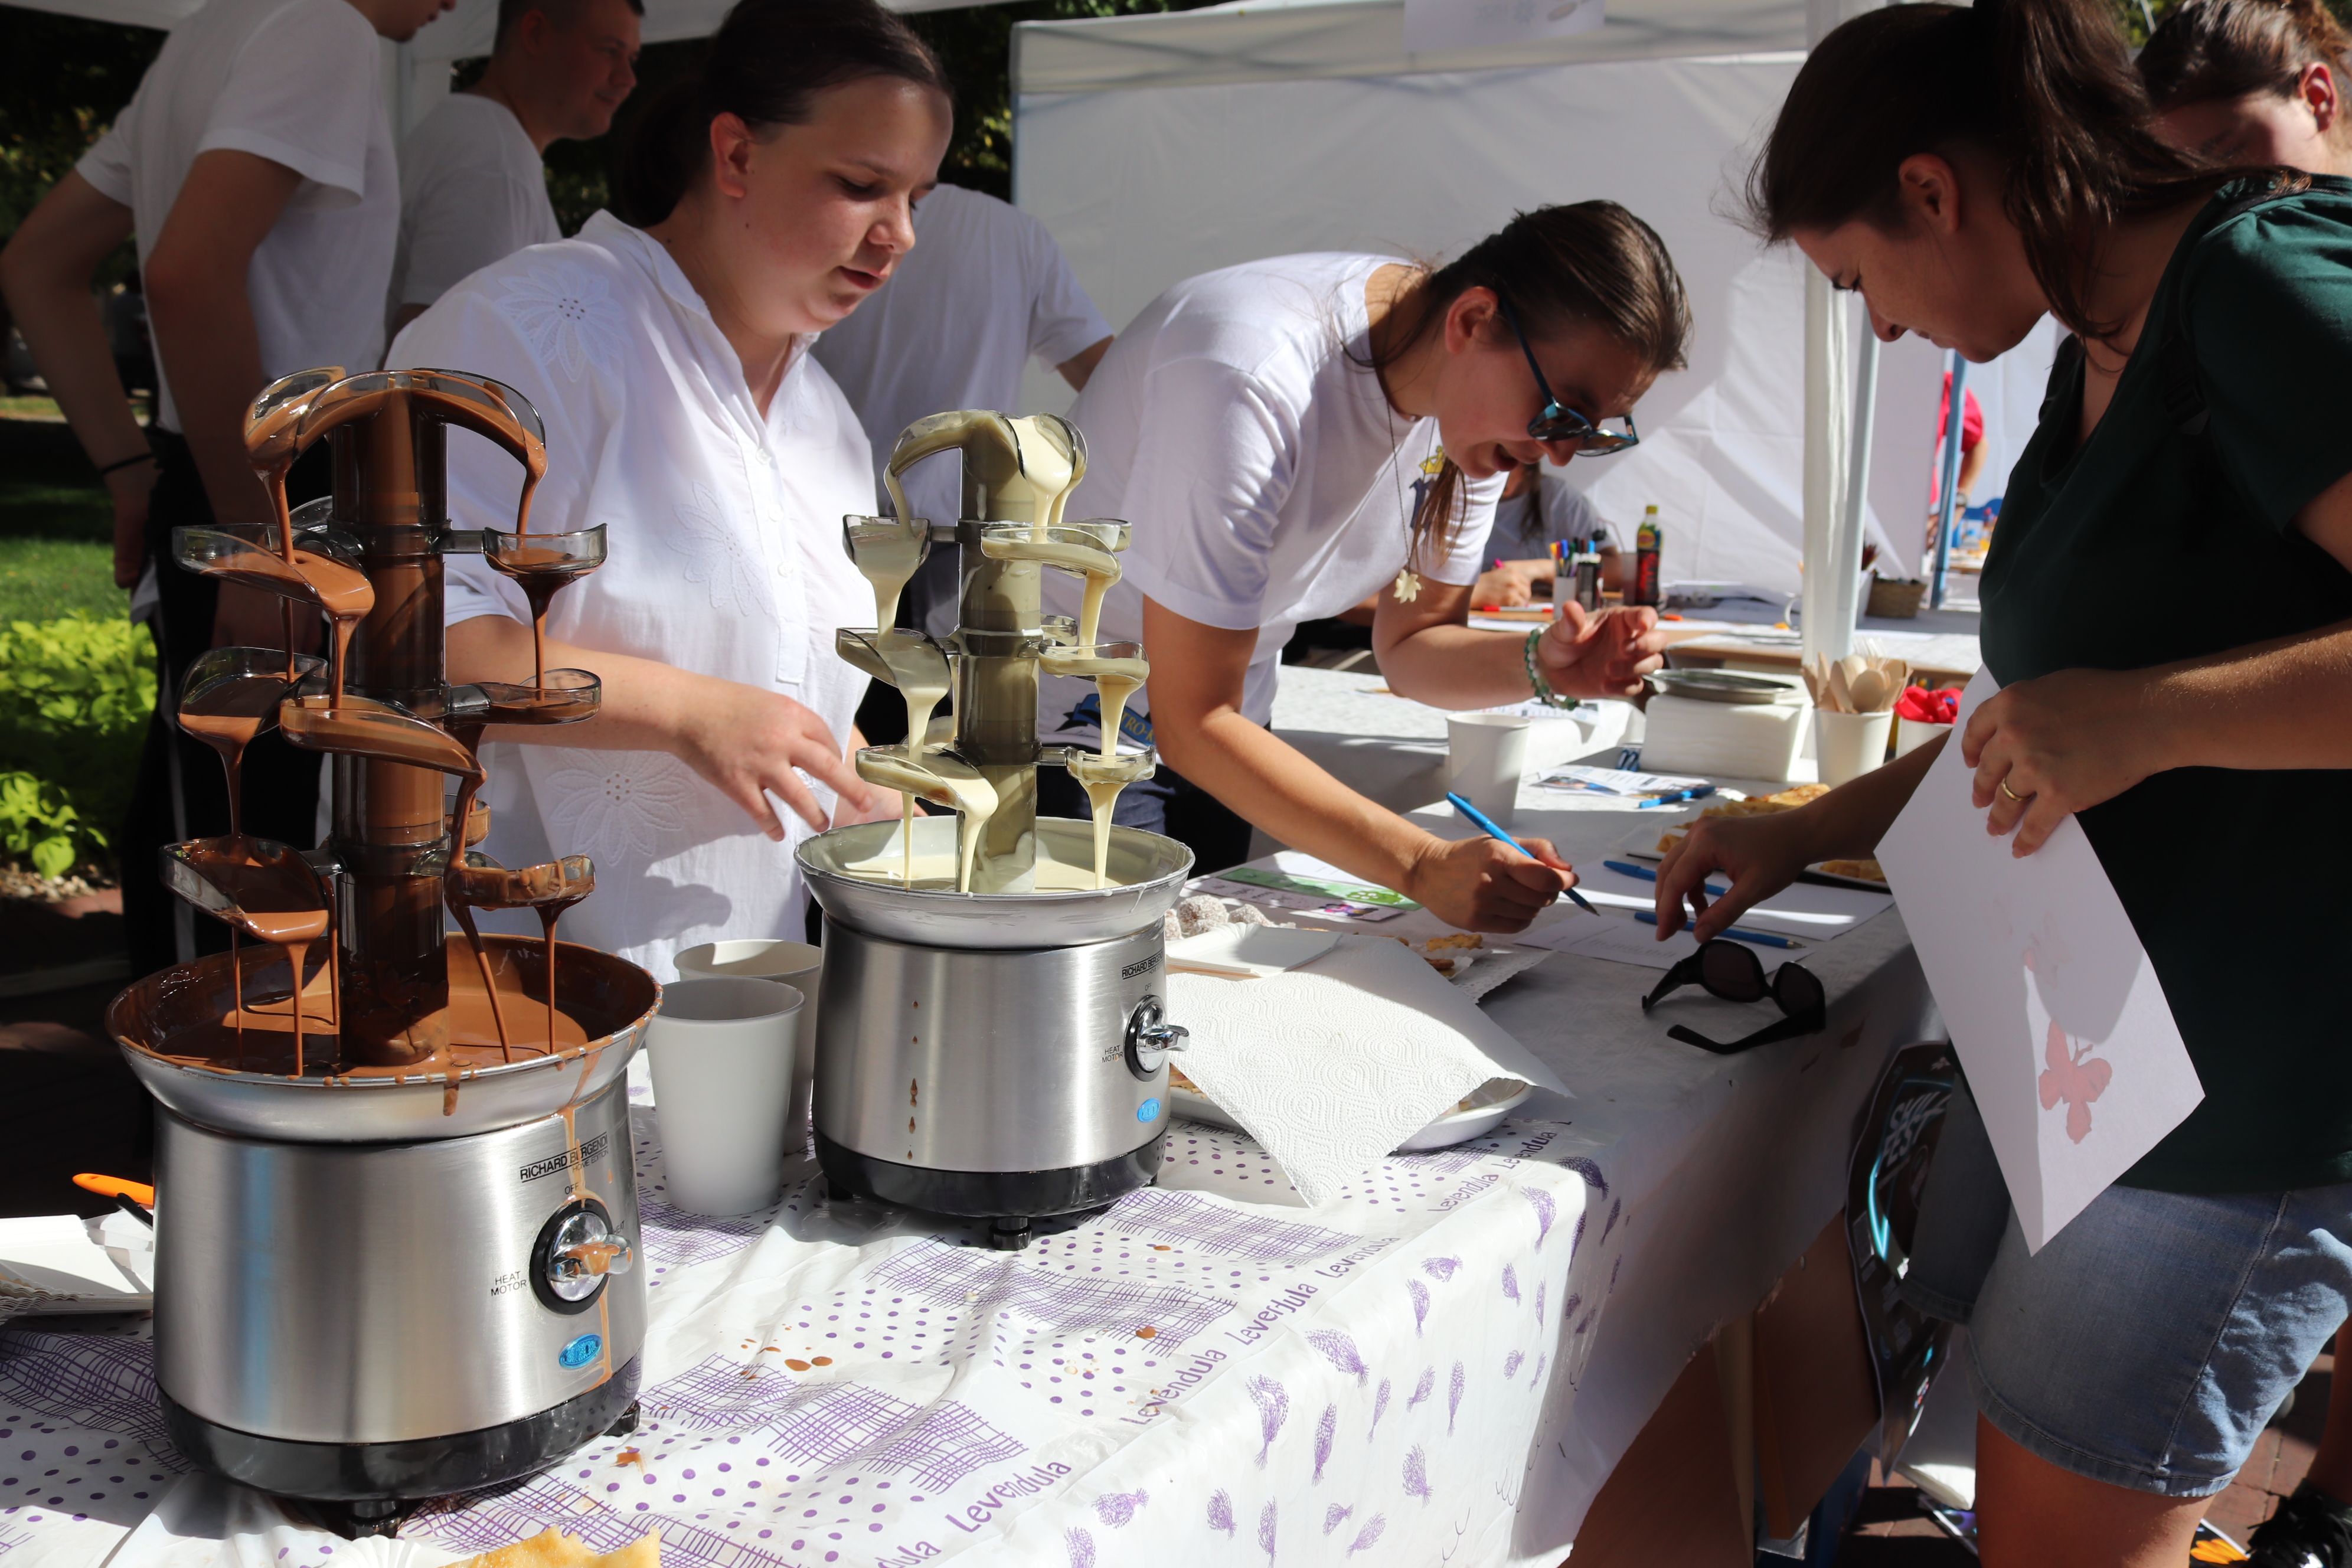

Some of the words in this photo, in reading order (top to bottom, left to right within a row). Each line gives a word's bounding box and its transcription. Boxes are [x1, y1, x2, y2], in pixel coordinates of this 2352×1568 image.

[1122, 961, 1147, 978] RICHARD
[1102, 1051, 1123, 1063] MOTOR
[1105, 1045, 1120, 1054] HEAT
[520, 1155, 567, 1180] RICHARD
[573, 1159, 590, 1173] HOME
[564, 1182, 579, 1195] OFF
[495, 1270, 521, 1285] HEAT
[491, 1279, 527, 1296] MOTOR
[945, 1462, 1072, 1533] Levendula
[1119, 1349, 1227, 1425] Levendula
[1314, 1237, 1401, 1278] Levendula
[1427, 1174, 1499, 1211] Levendula
